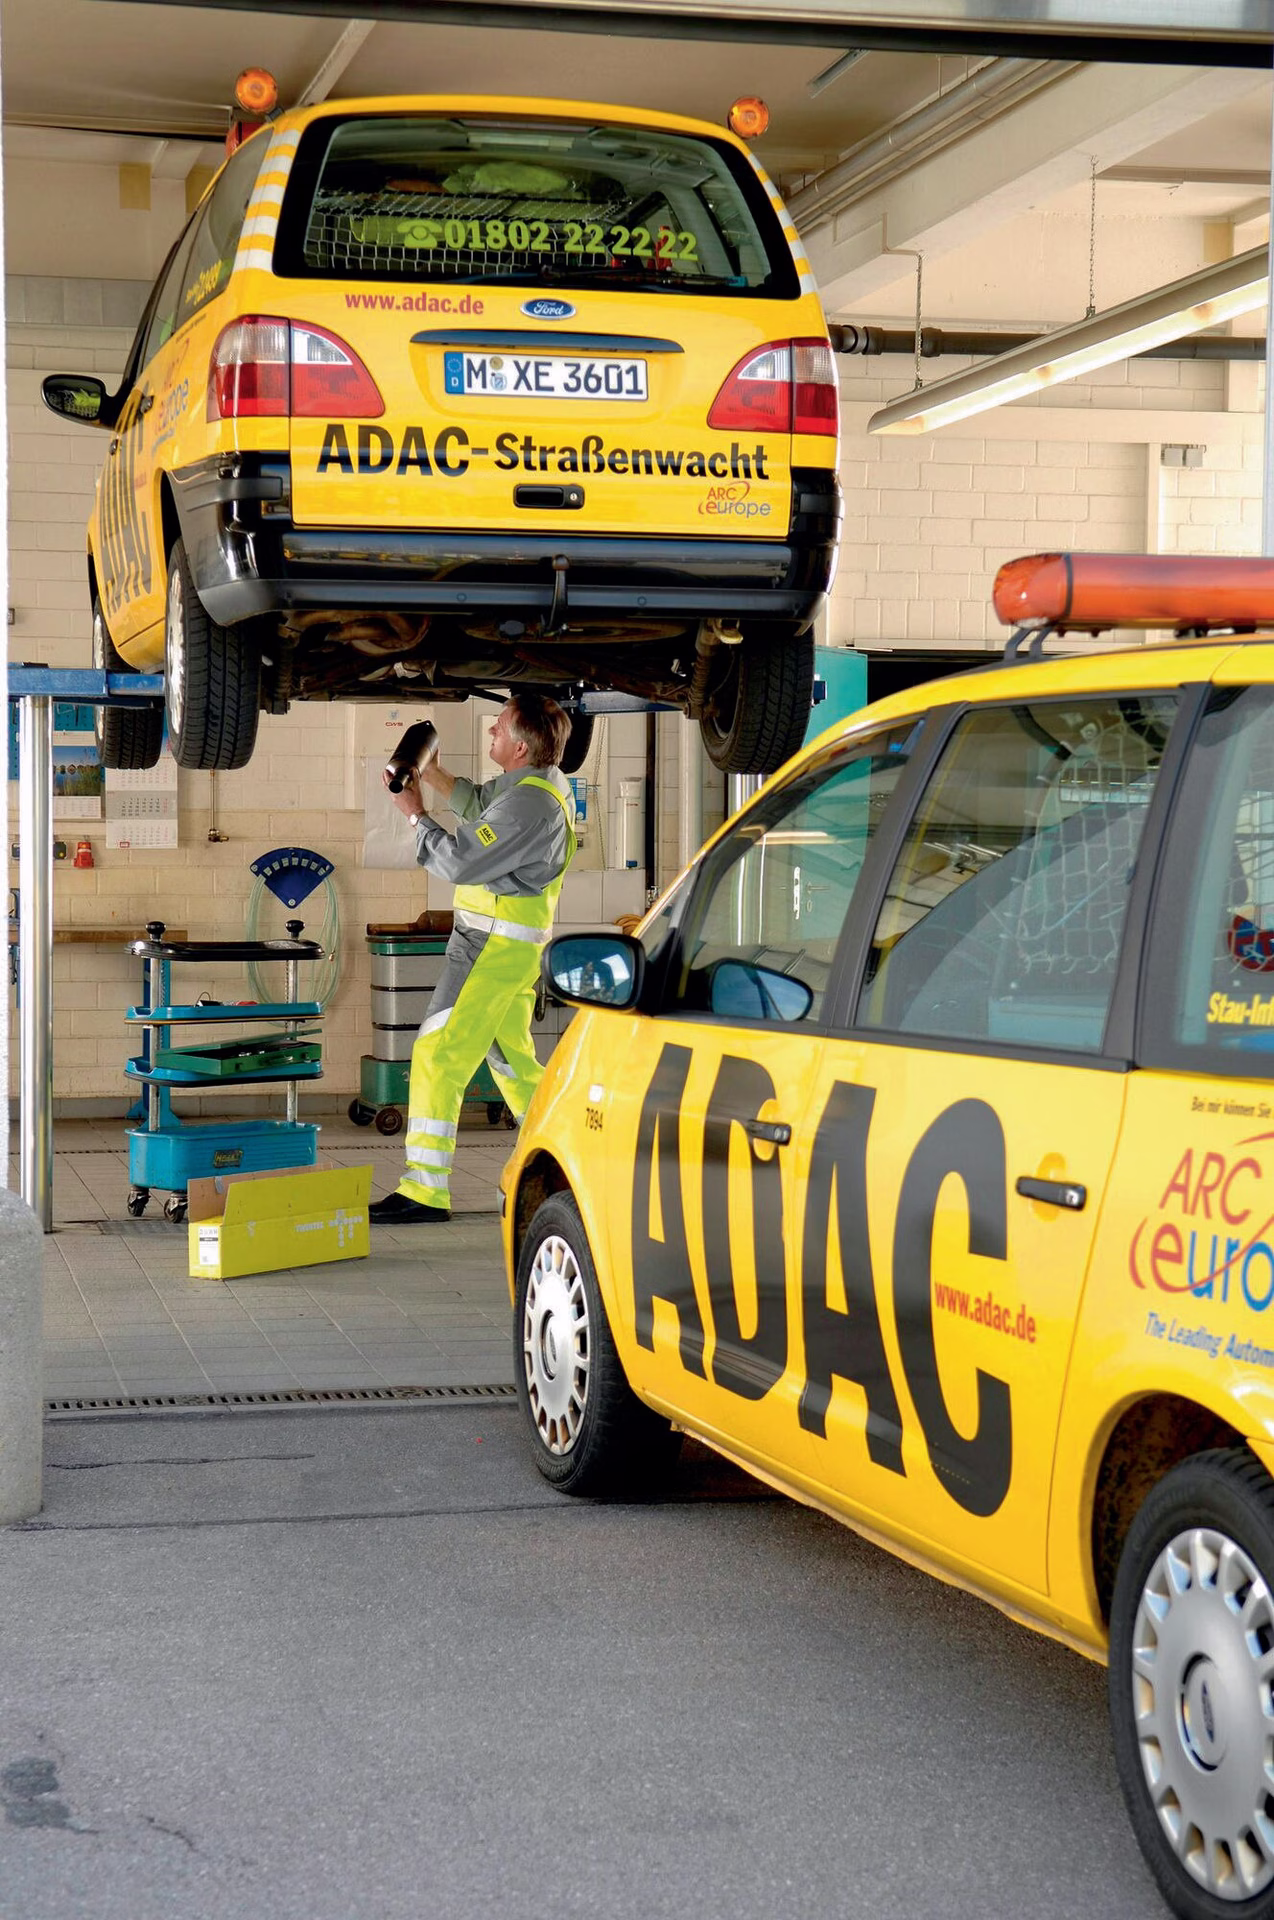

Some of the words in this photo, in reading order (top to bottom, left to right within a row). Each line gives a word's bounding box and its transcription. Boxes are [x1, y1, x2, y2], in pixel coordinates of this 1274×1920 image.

[444, 219, 551, 251] 01802
[345, 292, 484, 315] www.adac.de
[532, 300, 565, 316] Ford
[466, 358, 487, 389] M
[513, 360, 555, 392] XE
[563, 362, 643, 395] 3601
[316, 423, 770, 481] ADAC-Straßenwacht
[705, 501, 771, 518] europe
[706, 487, 737, 501] ARC
[585, 1107, 603, 1132] 7894
[1158, 1147, 1262, 1226] ARC
[632, 1042, 1013, 1518] ADAC
[935, 1281, 1036, 1344] www.adac.de
[1145, 1311, 1167, 1340] The
[1168, 1318, 1223, 1358] Leading
